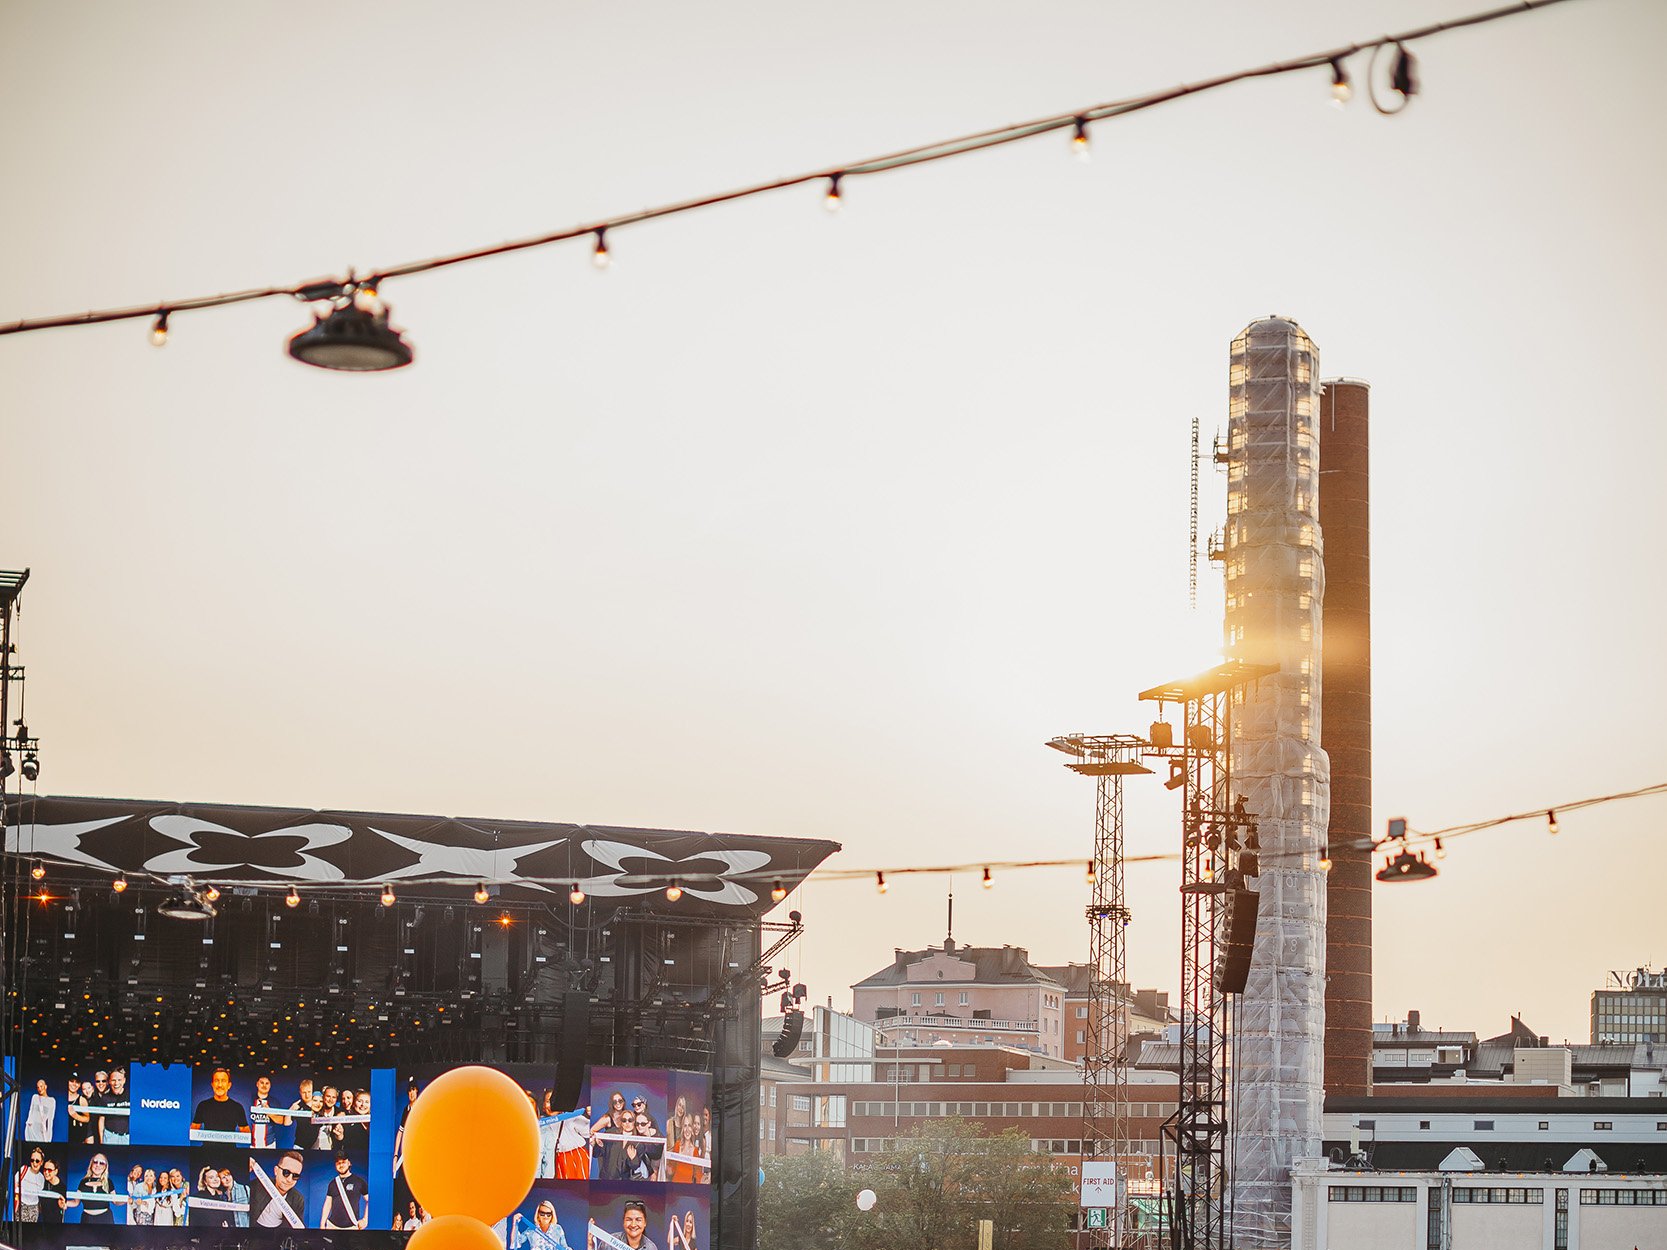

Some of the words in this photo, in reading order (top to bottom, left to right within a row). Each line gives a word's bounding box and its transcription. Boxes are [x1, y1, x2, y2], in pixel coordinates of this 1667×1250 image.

[141, 1098, 180, 1109] Nordea
[197, 1131, 232, 1140] Täydellinen
[234, 1133, 249, 1141] Flow
[1083, 1177, 1101, 1186] FIRST
[1102, 1177, 1115, 1186] AID
